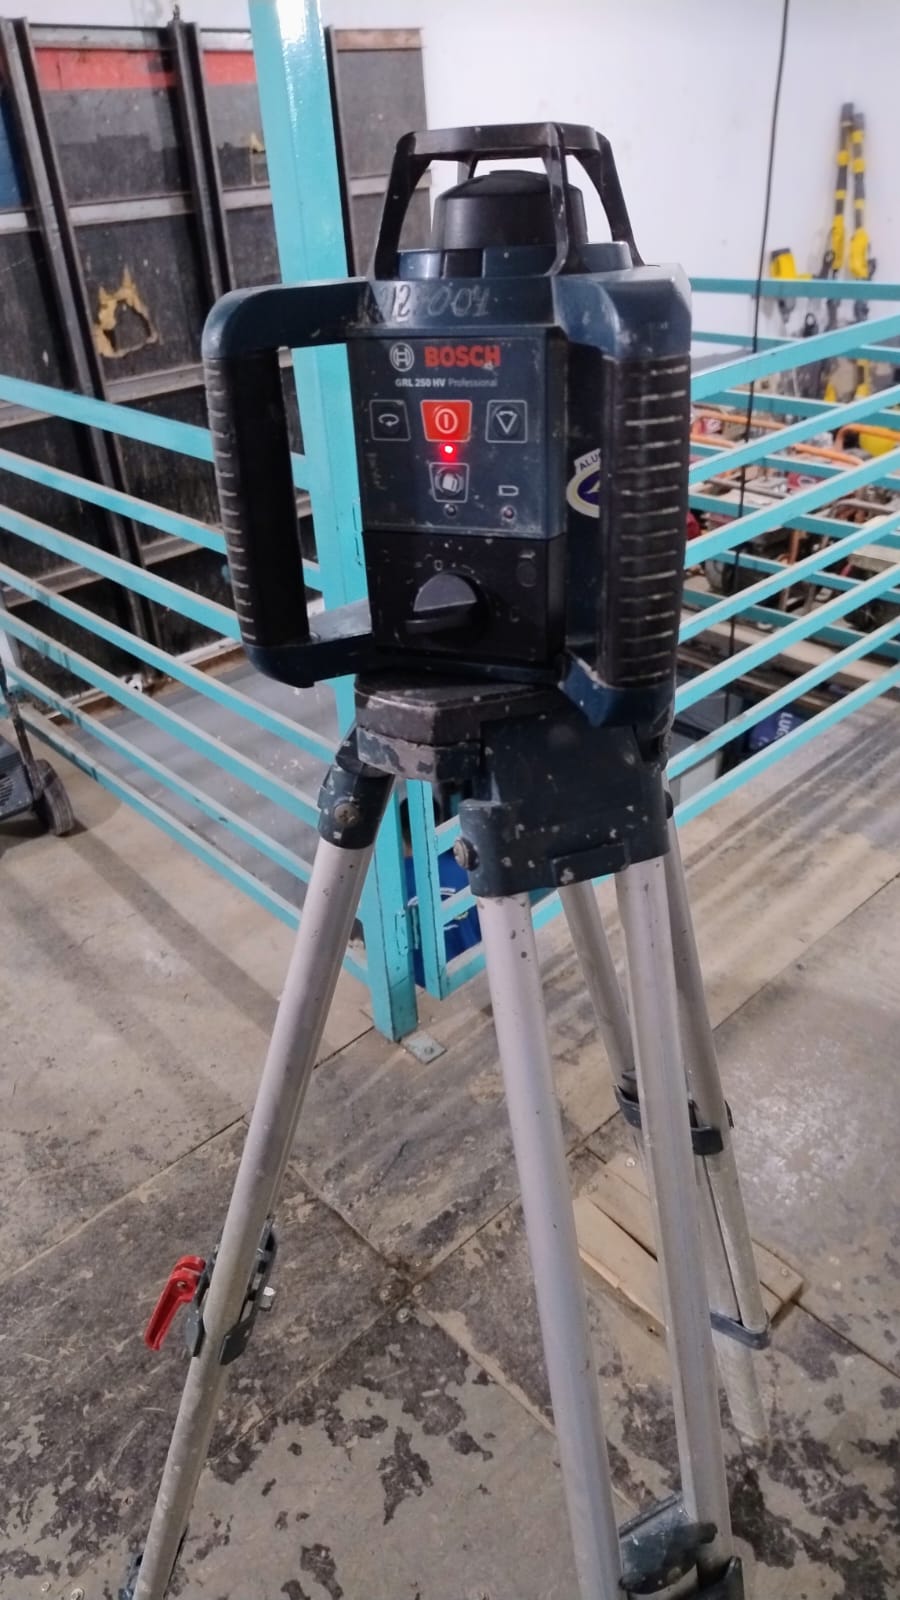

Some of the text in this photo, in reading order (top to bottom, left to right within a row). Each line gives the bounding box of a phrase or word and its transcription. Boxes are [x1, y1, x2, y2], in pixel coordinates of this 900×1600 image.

[424, 345, 502, 368] BOSCH
[395, 378, 498, 387] GRL 250 HV Professional
